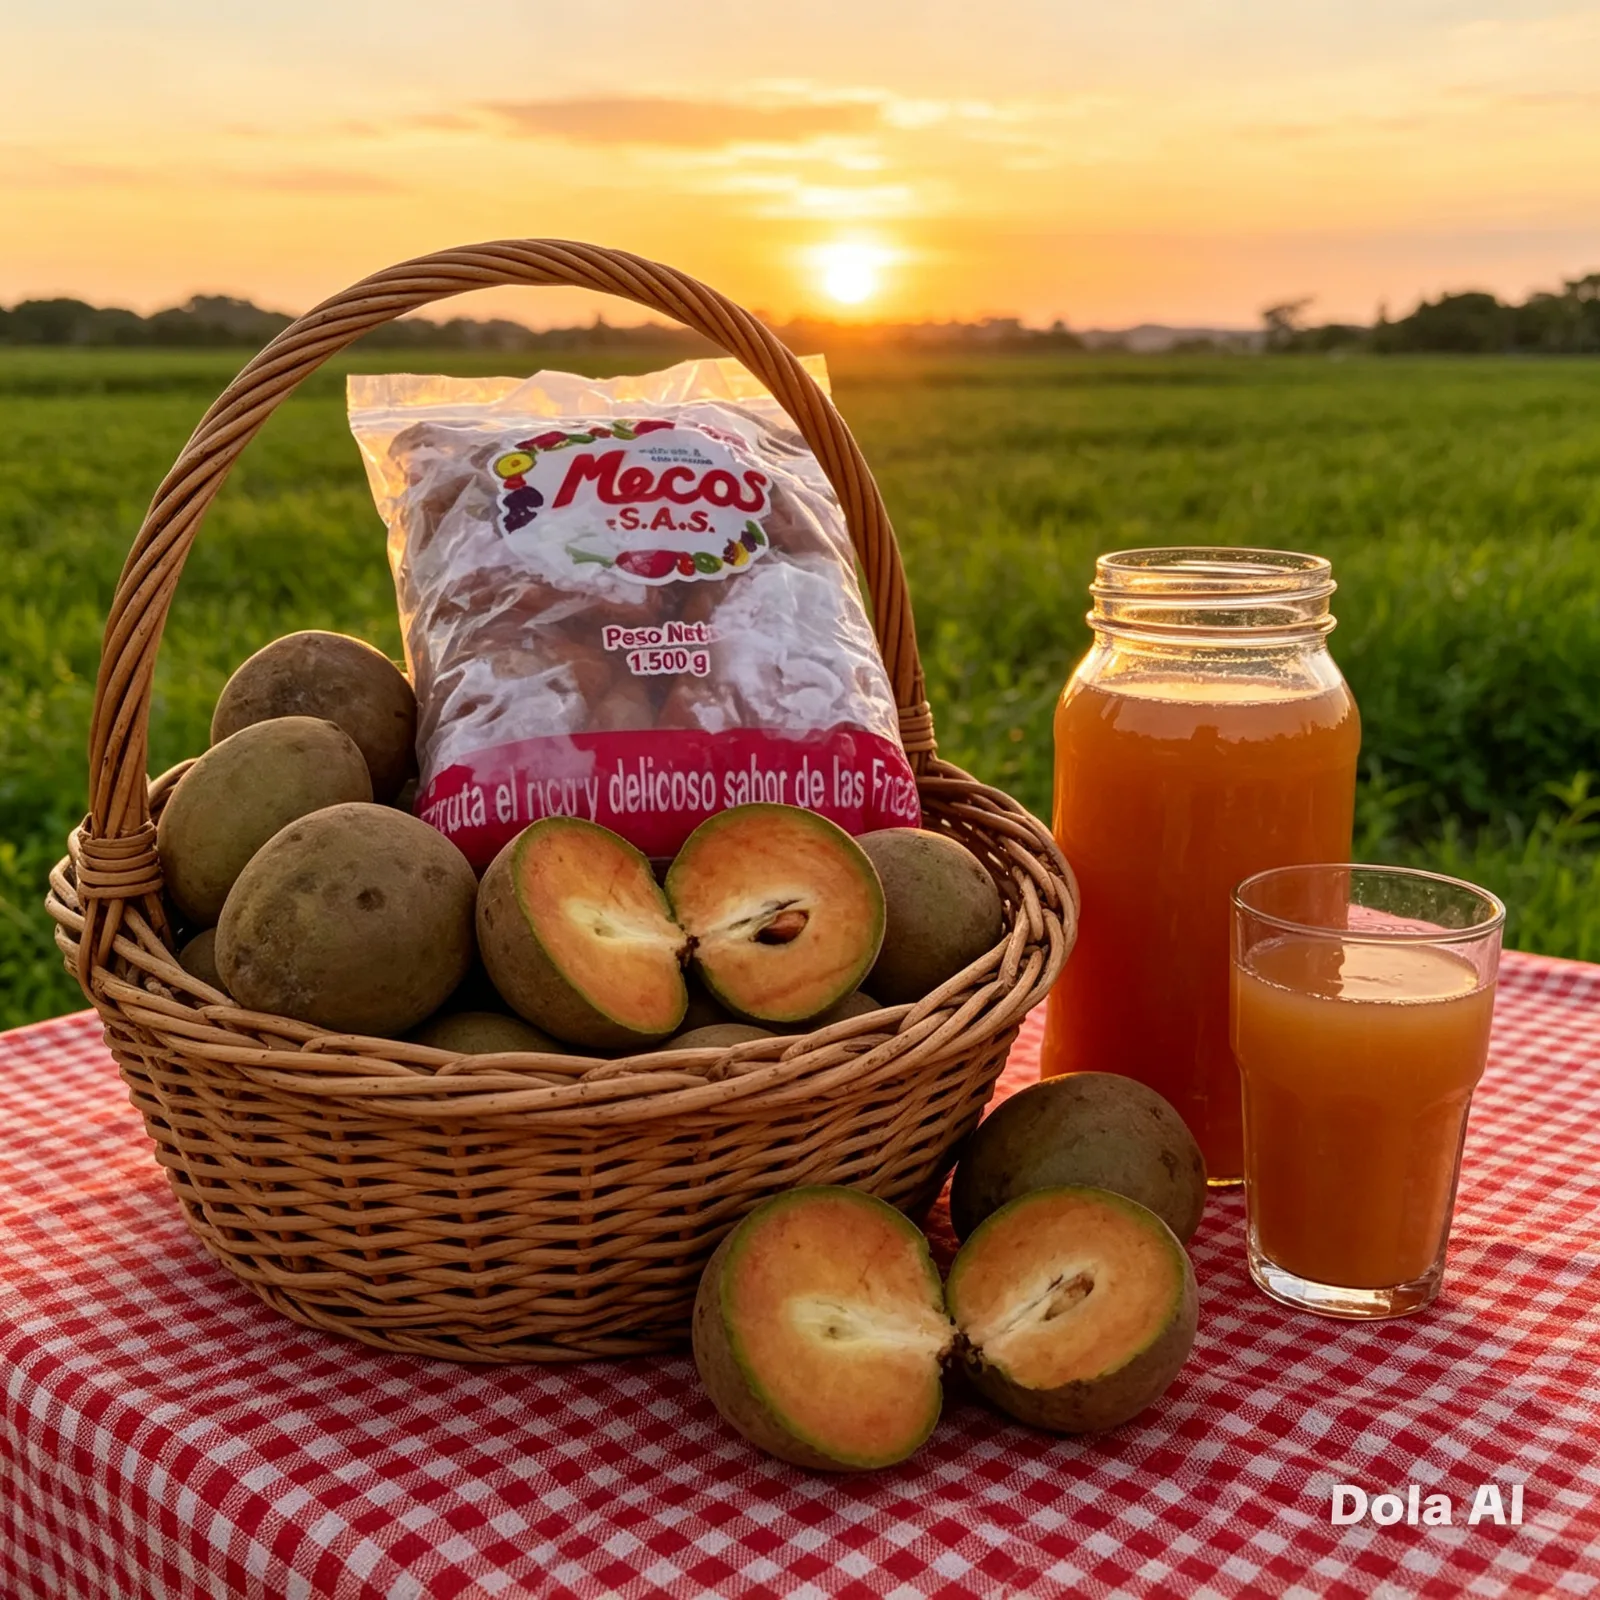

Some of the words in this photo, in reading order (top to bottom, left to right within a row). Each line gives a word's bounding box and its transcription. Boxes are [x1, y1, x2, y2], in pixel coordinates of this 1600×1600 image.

[552, 450, 767, 512] Mecos
[606, 628, 662, 647] Peso
[631, 651, 687, 671] 1.500
[693, 654, 707, 674] g
[495, 765, 518, 824] el
[584, 776, 599, 823] y
[724, 753, 787, 808] sabor
[795, 755, 824, 808] de
[833, 755, 866, 808] las
